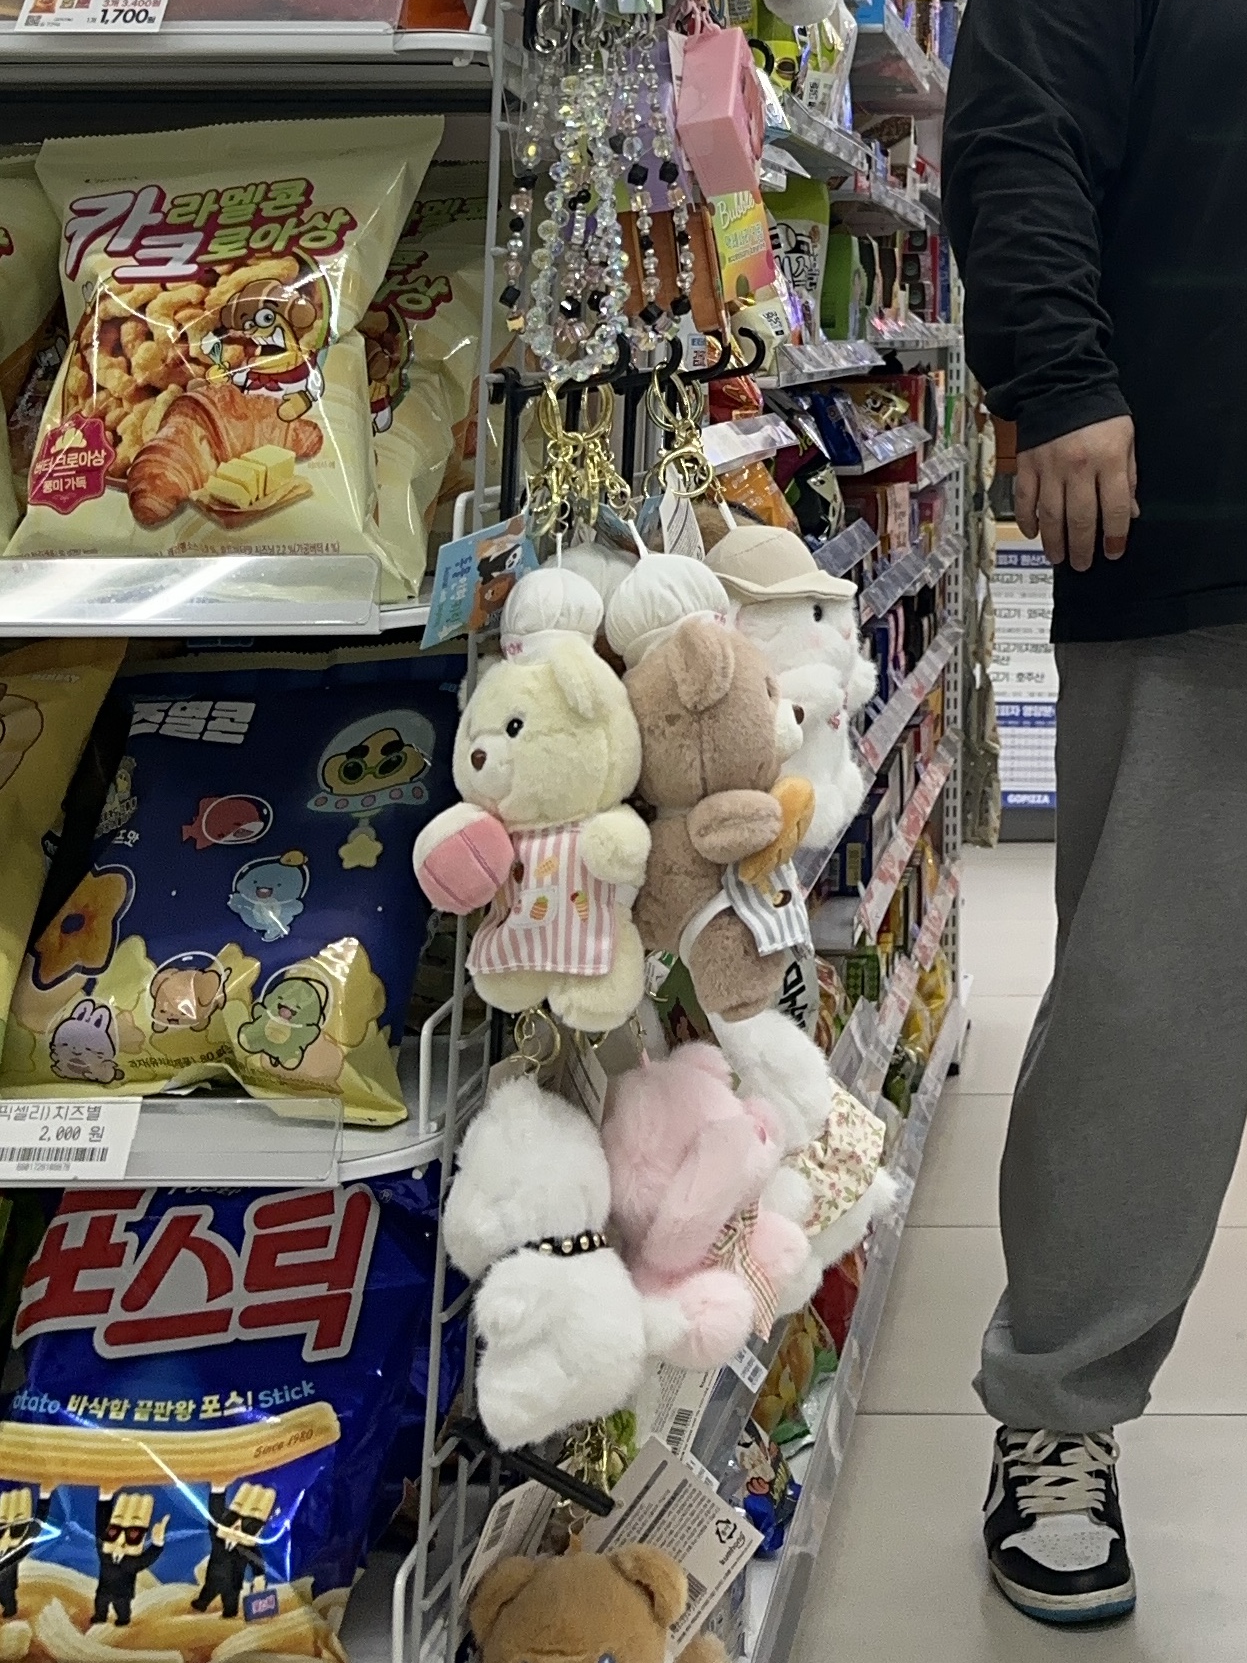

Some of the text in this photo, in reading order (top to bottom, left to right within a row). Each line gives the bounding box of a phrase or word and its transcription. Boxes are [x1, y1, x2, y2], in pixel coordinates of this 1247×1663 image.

[1006, 793, 1051, 806] GOPIZZA
[38, 1125, 106, 1144] 2,000 원
[15, 1188, 374, 1352] 포스틱
[66, 1393, 131, 1421] 바삭함
[257, 1379, 316, 1410] Stick
